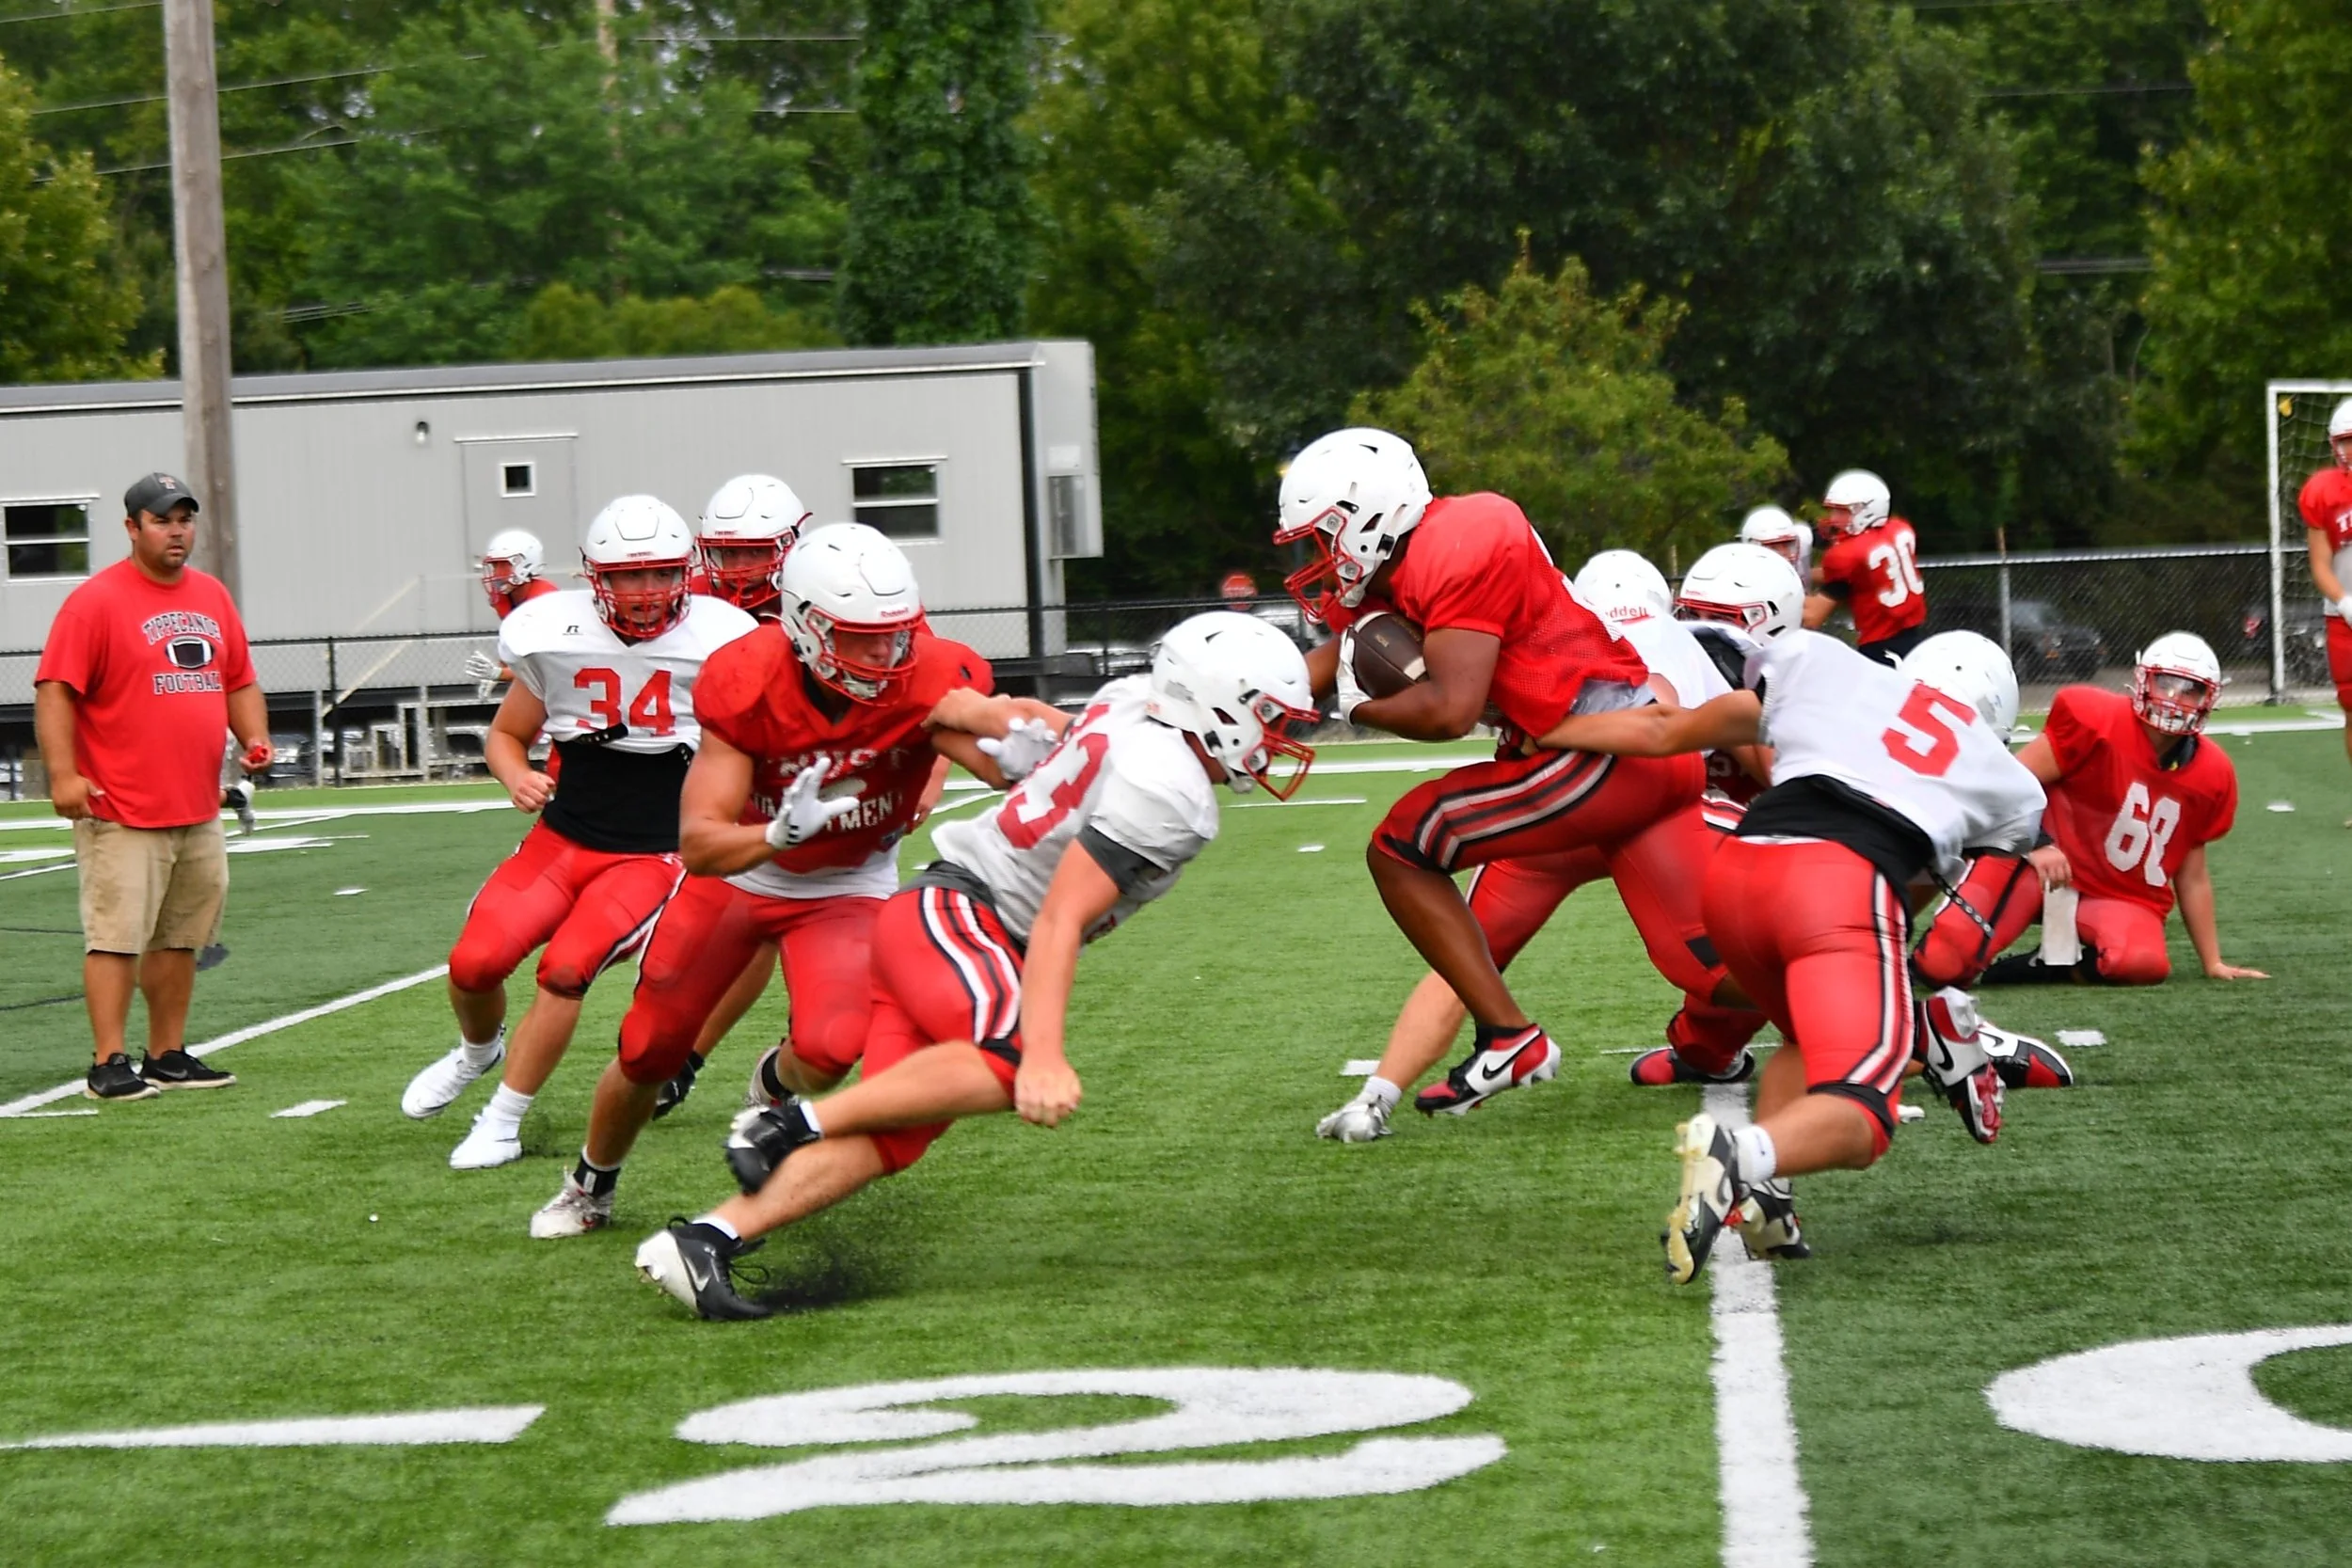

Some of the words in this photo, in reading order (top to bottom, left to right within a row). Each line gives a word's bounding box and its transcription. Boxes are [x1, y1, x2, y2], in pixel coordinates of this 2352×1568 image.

[2336, 510, 2352, 532] T
[1868, 530, 1924, 608] 30
[1605, 606, 1648, 621] ddell
[153, 672, 223, 695] FOOTBAL
[574, 668, 676, 737] 34
[1882, 683, 1978, 777] 5
[2105, 782, 2181, 888] 68
[605, 1367, 1507, 1526] 2
